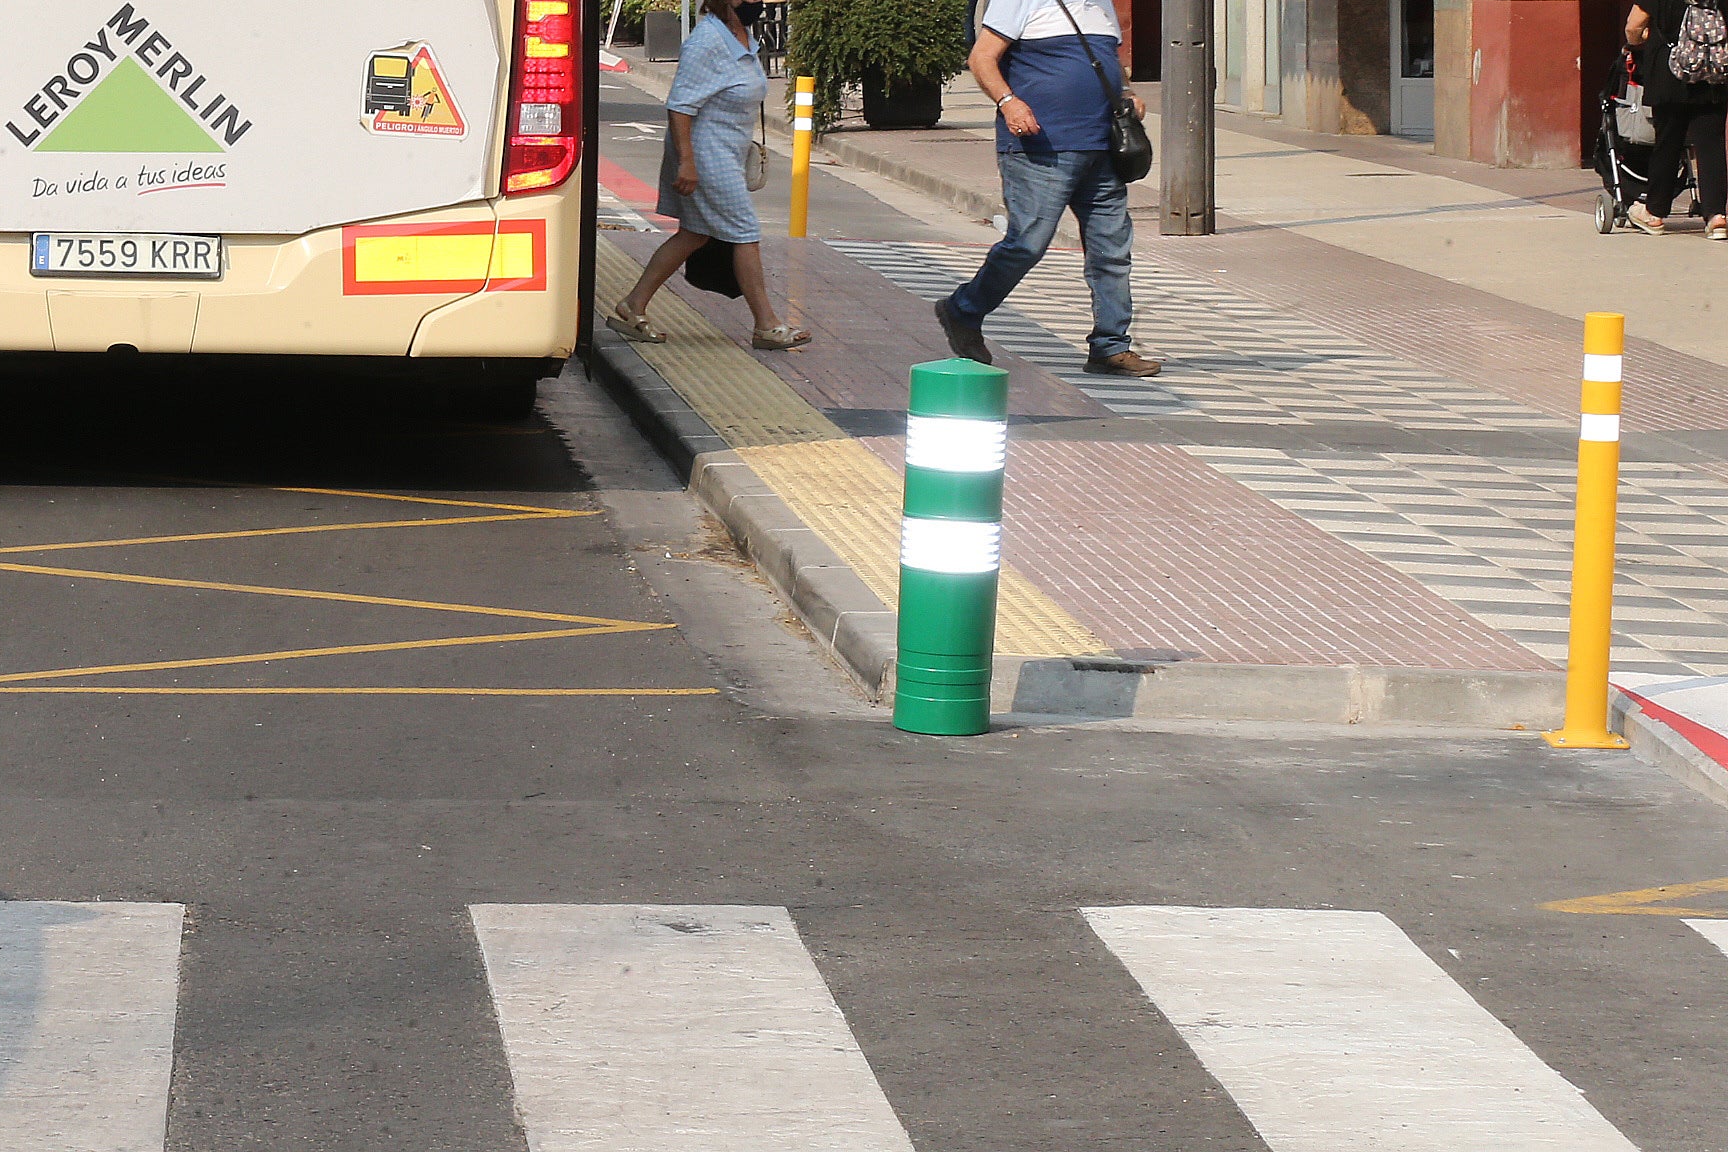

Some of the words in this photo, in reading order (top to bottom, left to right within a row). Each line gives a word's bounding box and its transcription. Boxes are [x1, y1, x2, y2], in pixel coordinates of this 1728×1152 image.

[5, 27, 117, 147] LEROY
[106, 2, 253, 146] MERLIN
[375, 122, 414, 132] PELIGRO
[32, 177, 59, 198] Da
[65, 169, 109, 194] vida
[115, 176, 128, 189] a
[137, 164, 166, 186] tus
[171, 160, 227, 184] ideas
[38, 255, 46, 265] E
[56, 238, 138, 268] 7559
[150, 239, 212, 270] KRR
